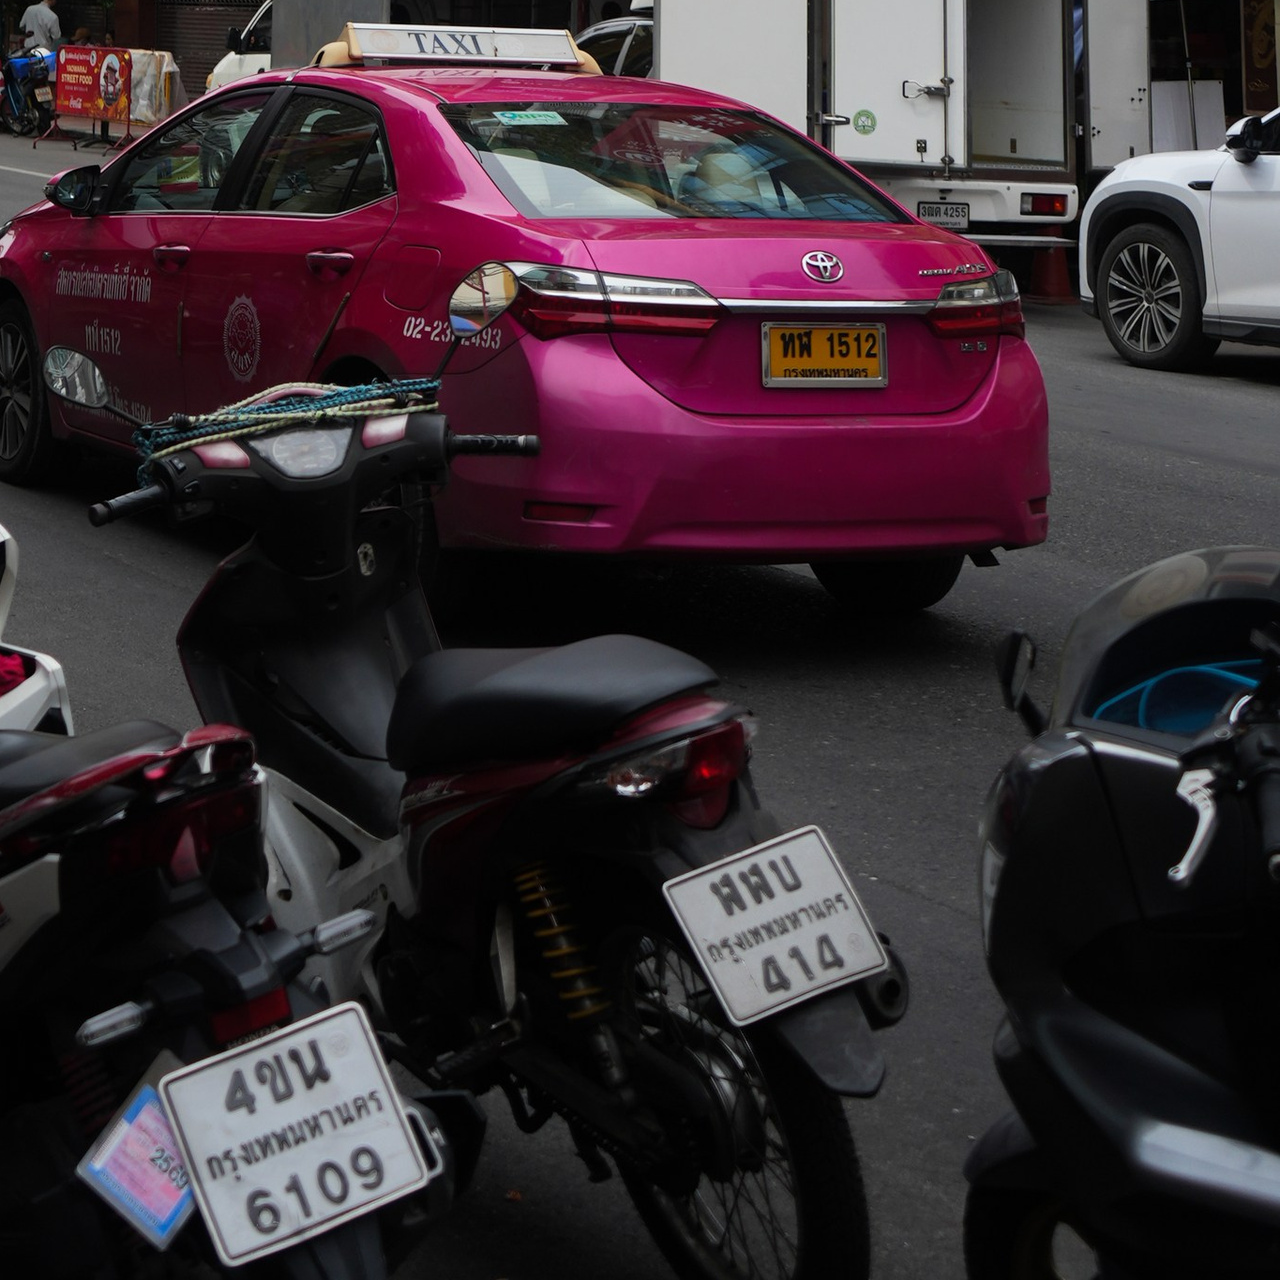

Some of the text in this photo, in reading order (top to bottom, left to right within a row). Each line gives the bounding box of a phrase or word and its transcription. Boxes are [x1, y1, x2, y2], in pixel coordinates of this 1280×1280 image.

[407, 32, 484, 55] TAXI
[61, 73, 93, 85] STREET FOOD
[944, 206, 966, 218] 4255
[100, 327, 121, 356] 1512
[826, 332, 877, 359] 1512
[783, 366, 869, 379] กรงเทพมหานคร
[706, 892, 850, 965] กรุงเทพมหานคร
[761, 933, 846, 995] 414
[224, 1039, 331, 1116] 4ขน
[206, 1089, 384, 1182] กรุงเทพมหานคร
[245, 1145, 385, 1236] 6109
